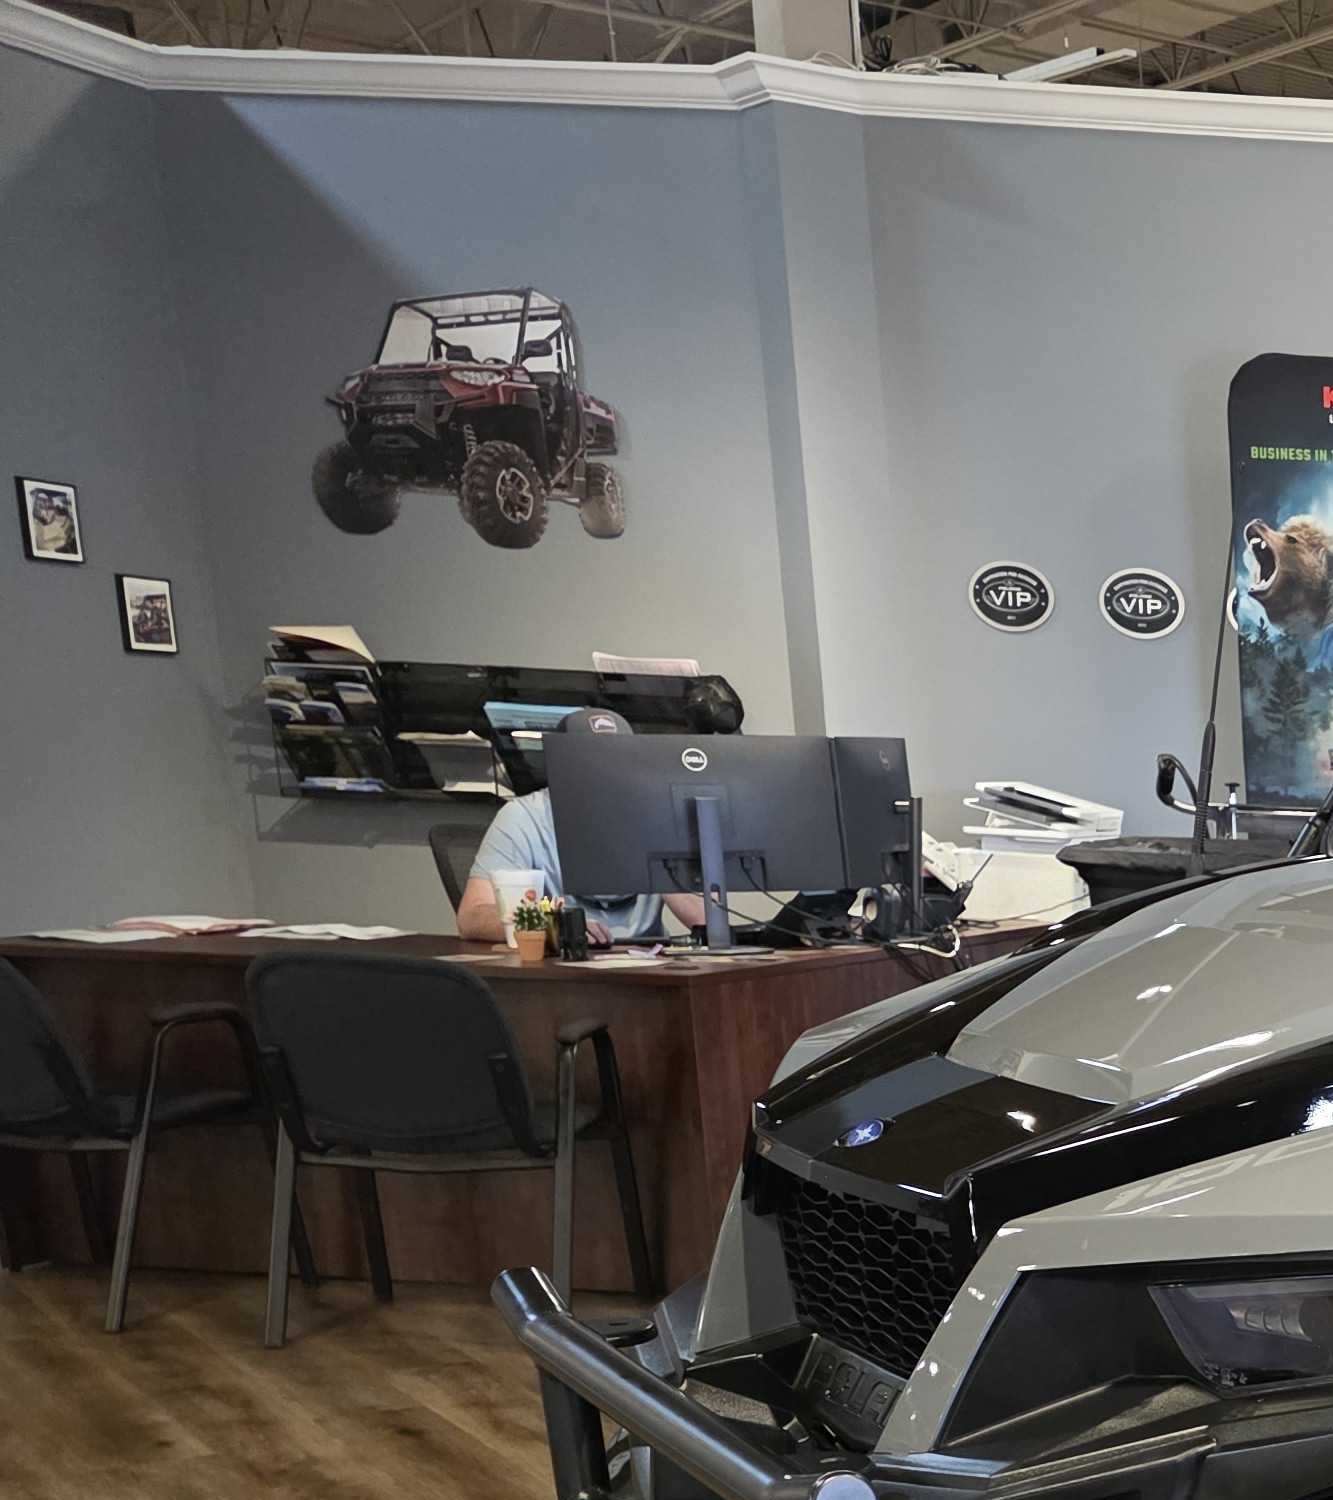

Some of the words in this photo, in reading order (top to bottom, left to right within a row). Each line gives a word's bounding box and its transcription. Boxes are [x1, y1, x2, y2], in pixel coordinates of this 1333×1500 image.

[1250, 446, 1311, 461] BUSINESS
[1314, 448, 1328, 462] IN
[988, 588, 1032, 608] VIP
[1119, 596, 1163, 615] VIP
[804, 1351, 903, 1426] POLA
